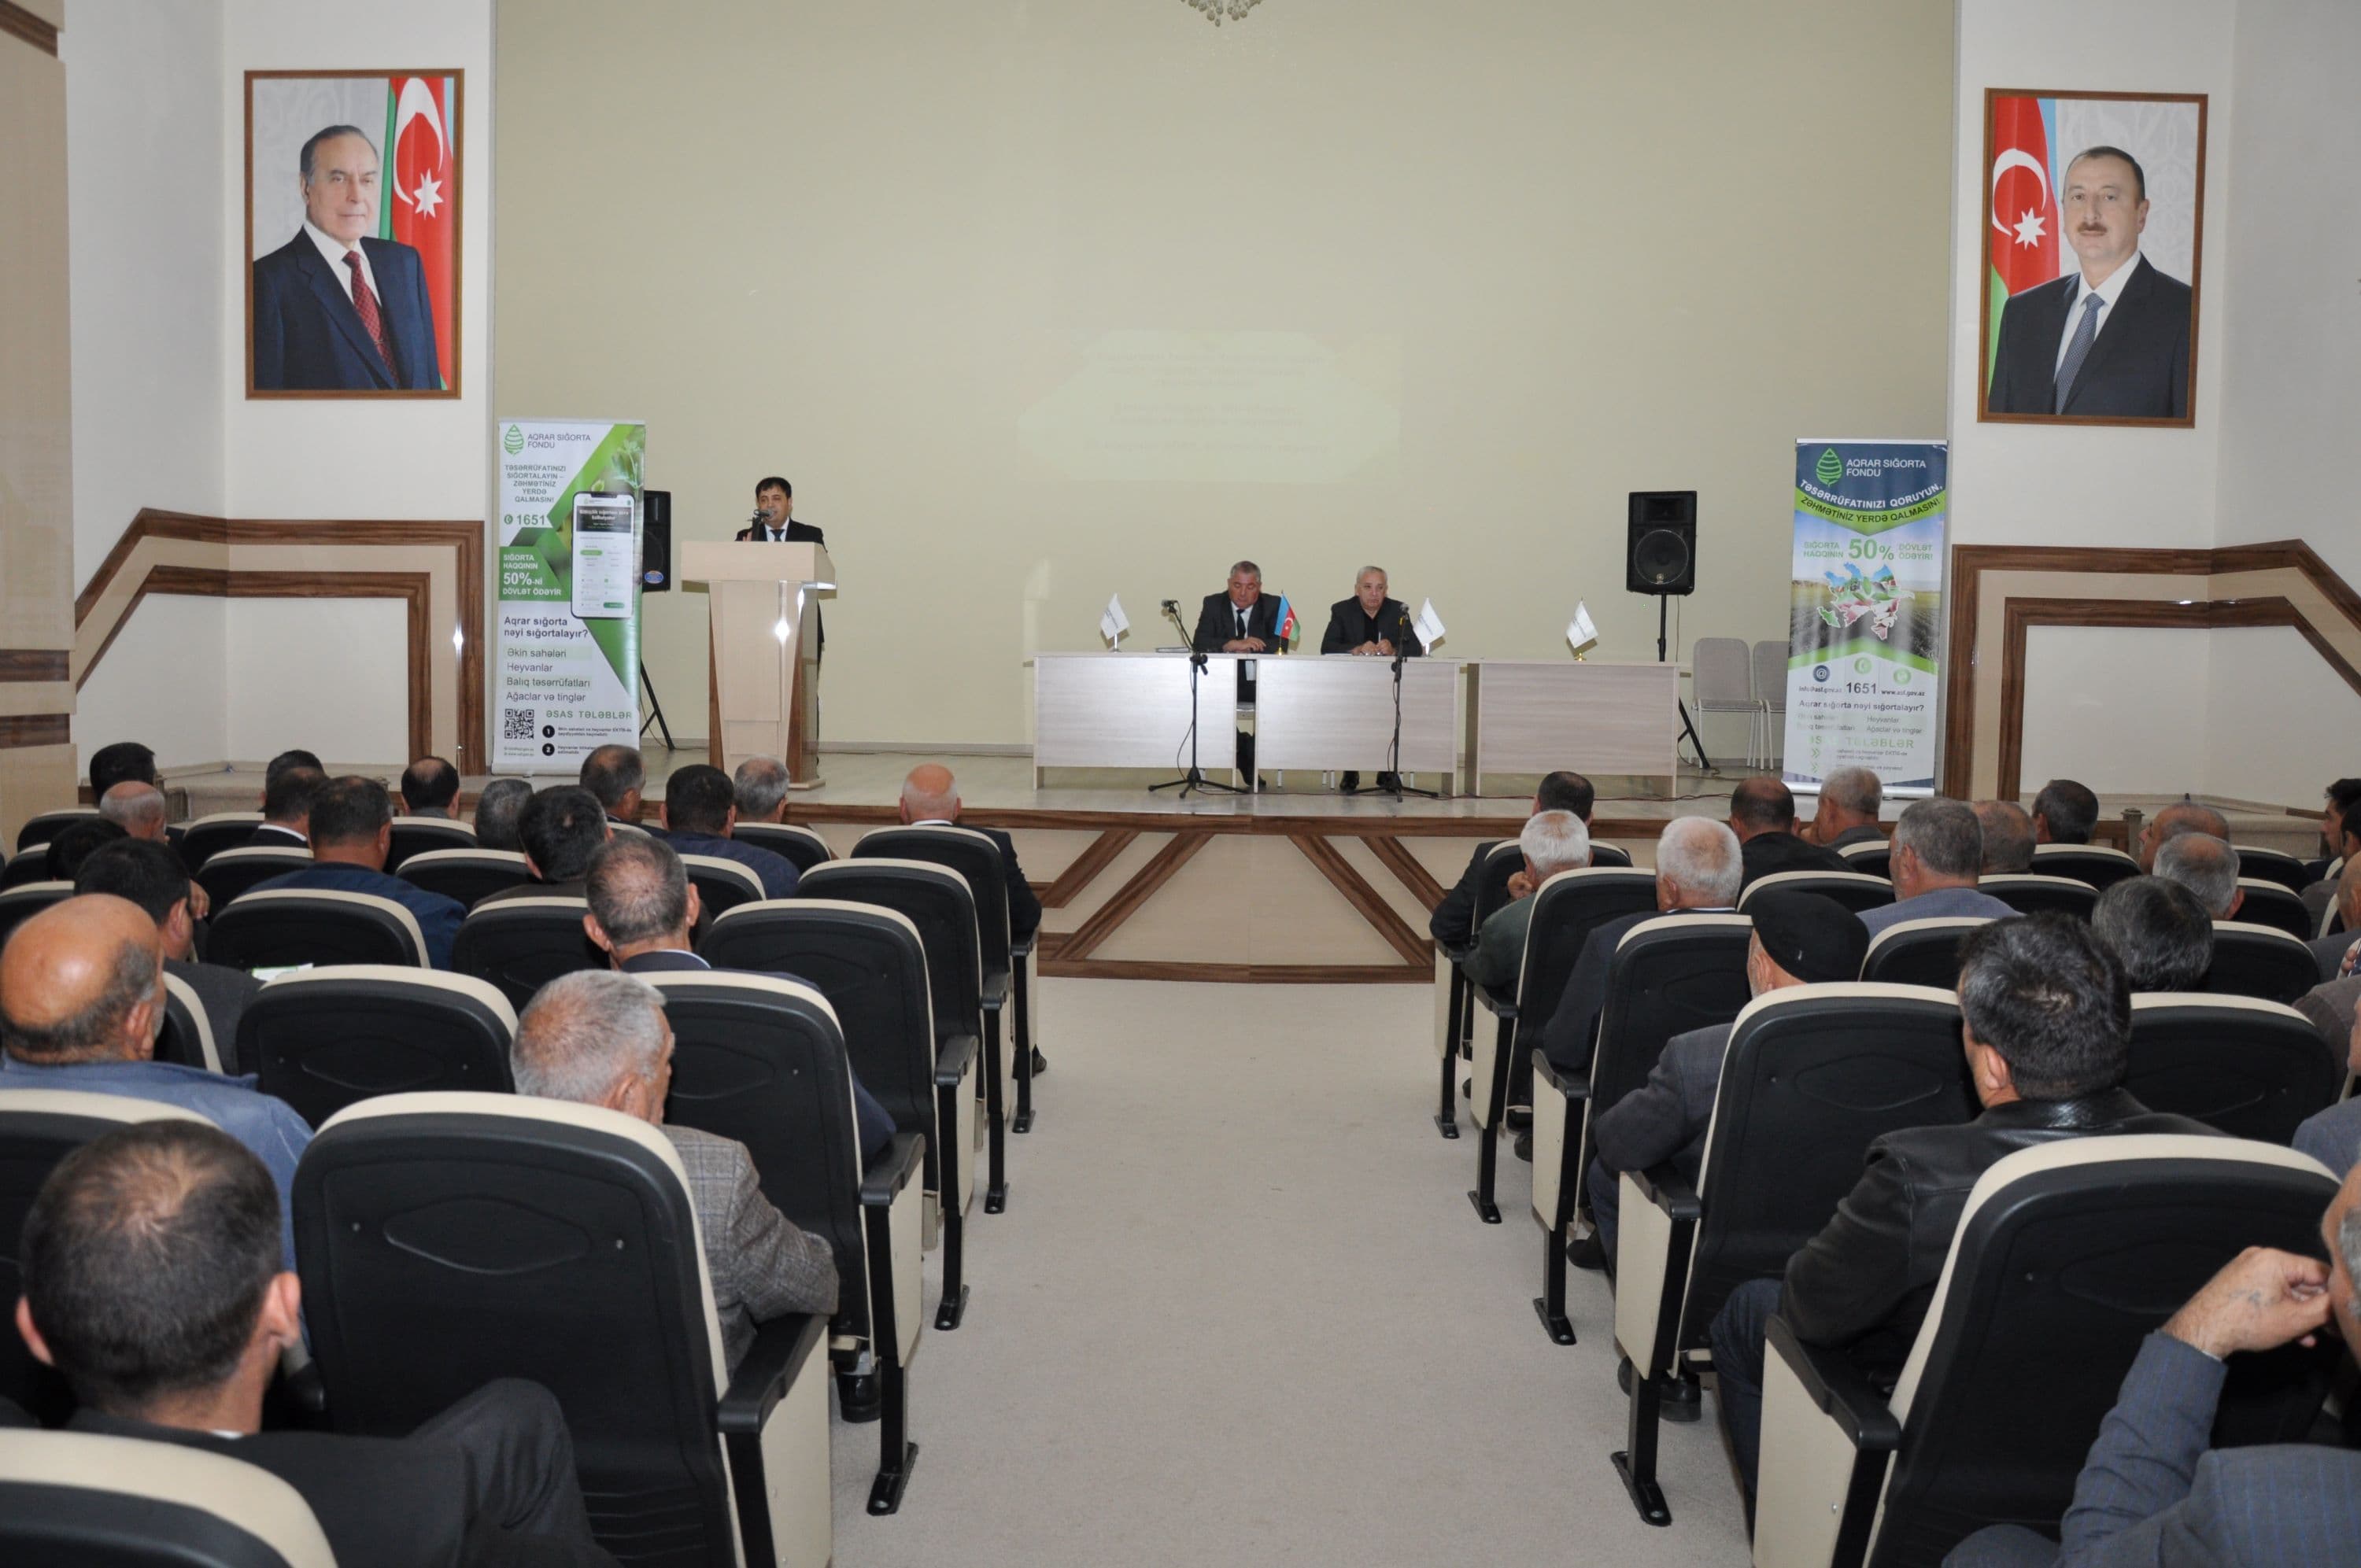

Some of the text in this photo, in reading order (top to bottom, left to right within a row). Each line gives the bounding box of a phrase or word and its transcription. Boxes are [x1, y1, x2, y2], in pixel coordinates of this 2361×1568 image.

[556, 433, 591, 441] SIĞORTA
[1846, 458, 1927, 468] AQRAR SIĞORTA
[1846, 468, 1881, 477] FONDU
[1800, 479, 1943, 509] TƏSƏRRÜFATINIZI QORUYUN,
[1801, 497, 1853, 522] ZƏHMƏTİNİZ
[1890, 498, 1940, 521] QALMASIN!
[517, 515, 545, 526] 1651
[1849, 538, 1894, 560] 50%
[504, 617, 567, 628] Aqrar sığorta
[504, 629, 588, 640] nəyi sığortalayır?
[507, 647, 567, 658] Əkin sahələri
[507, 662, 552, 673] Heyvanlar
[506, 677, 590, 688] Balıq təsərrüfatları
[1846, 682, 1876, 694] 1651
[506, 692, 541, 702] Ağaclar
[557, 693, 586, 703] tinglər
[1873, 703, 1924, 713] sığortalayır?
[546, 710, 632, 719] ƏSAS TƏLƏBLƏR
